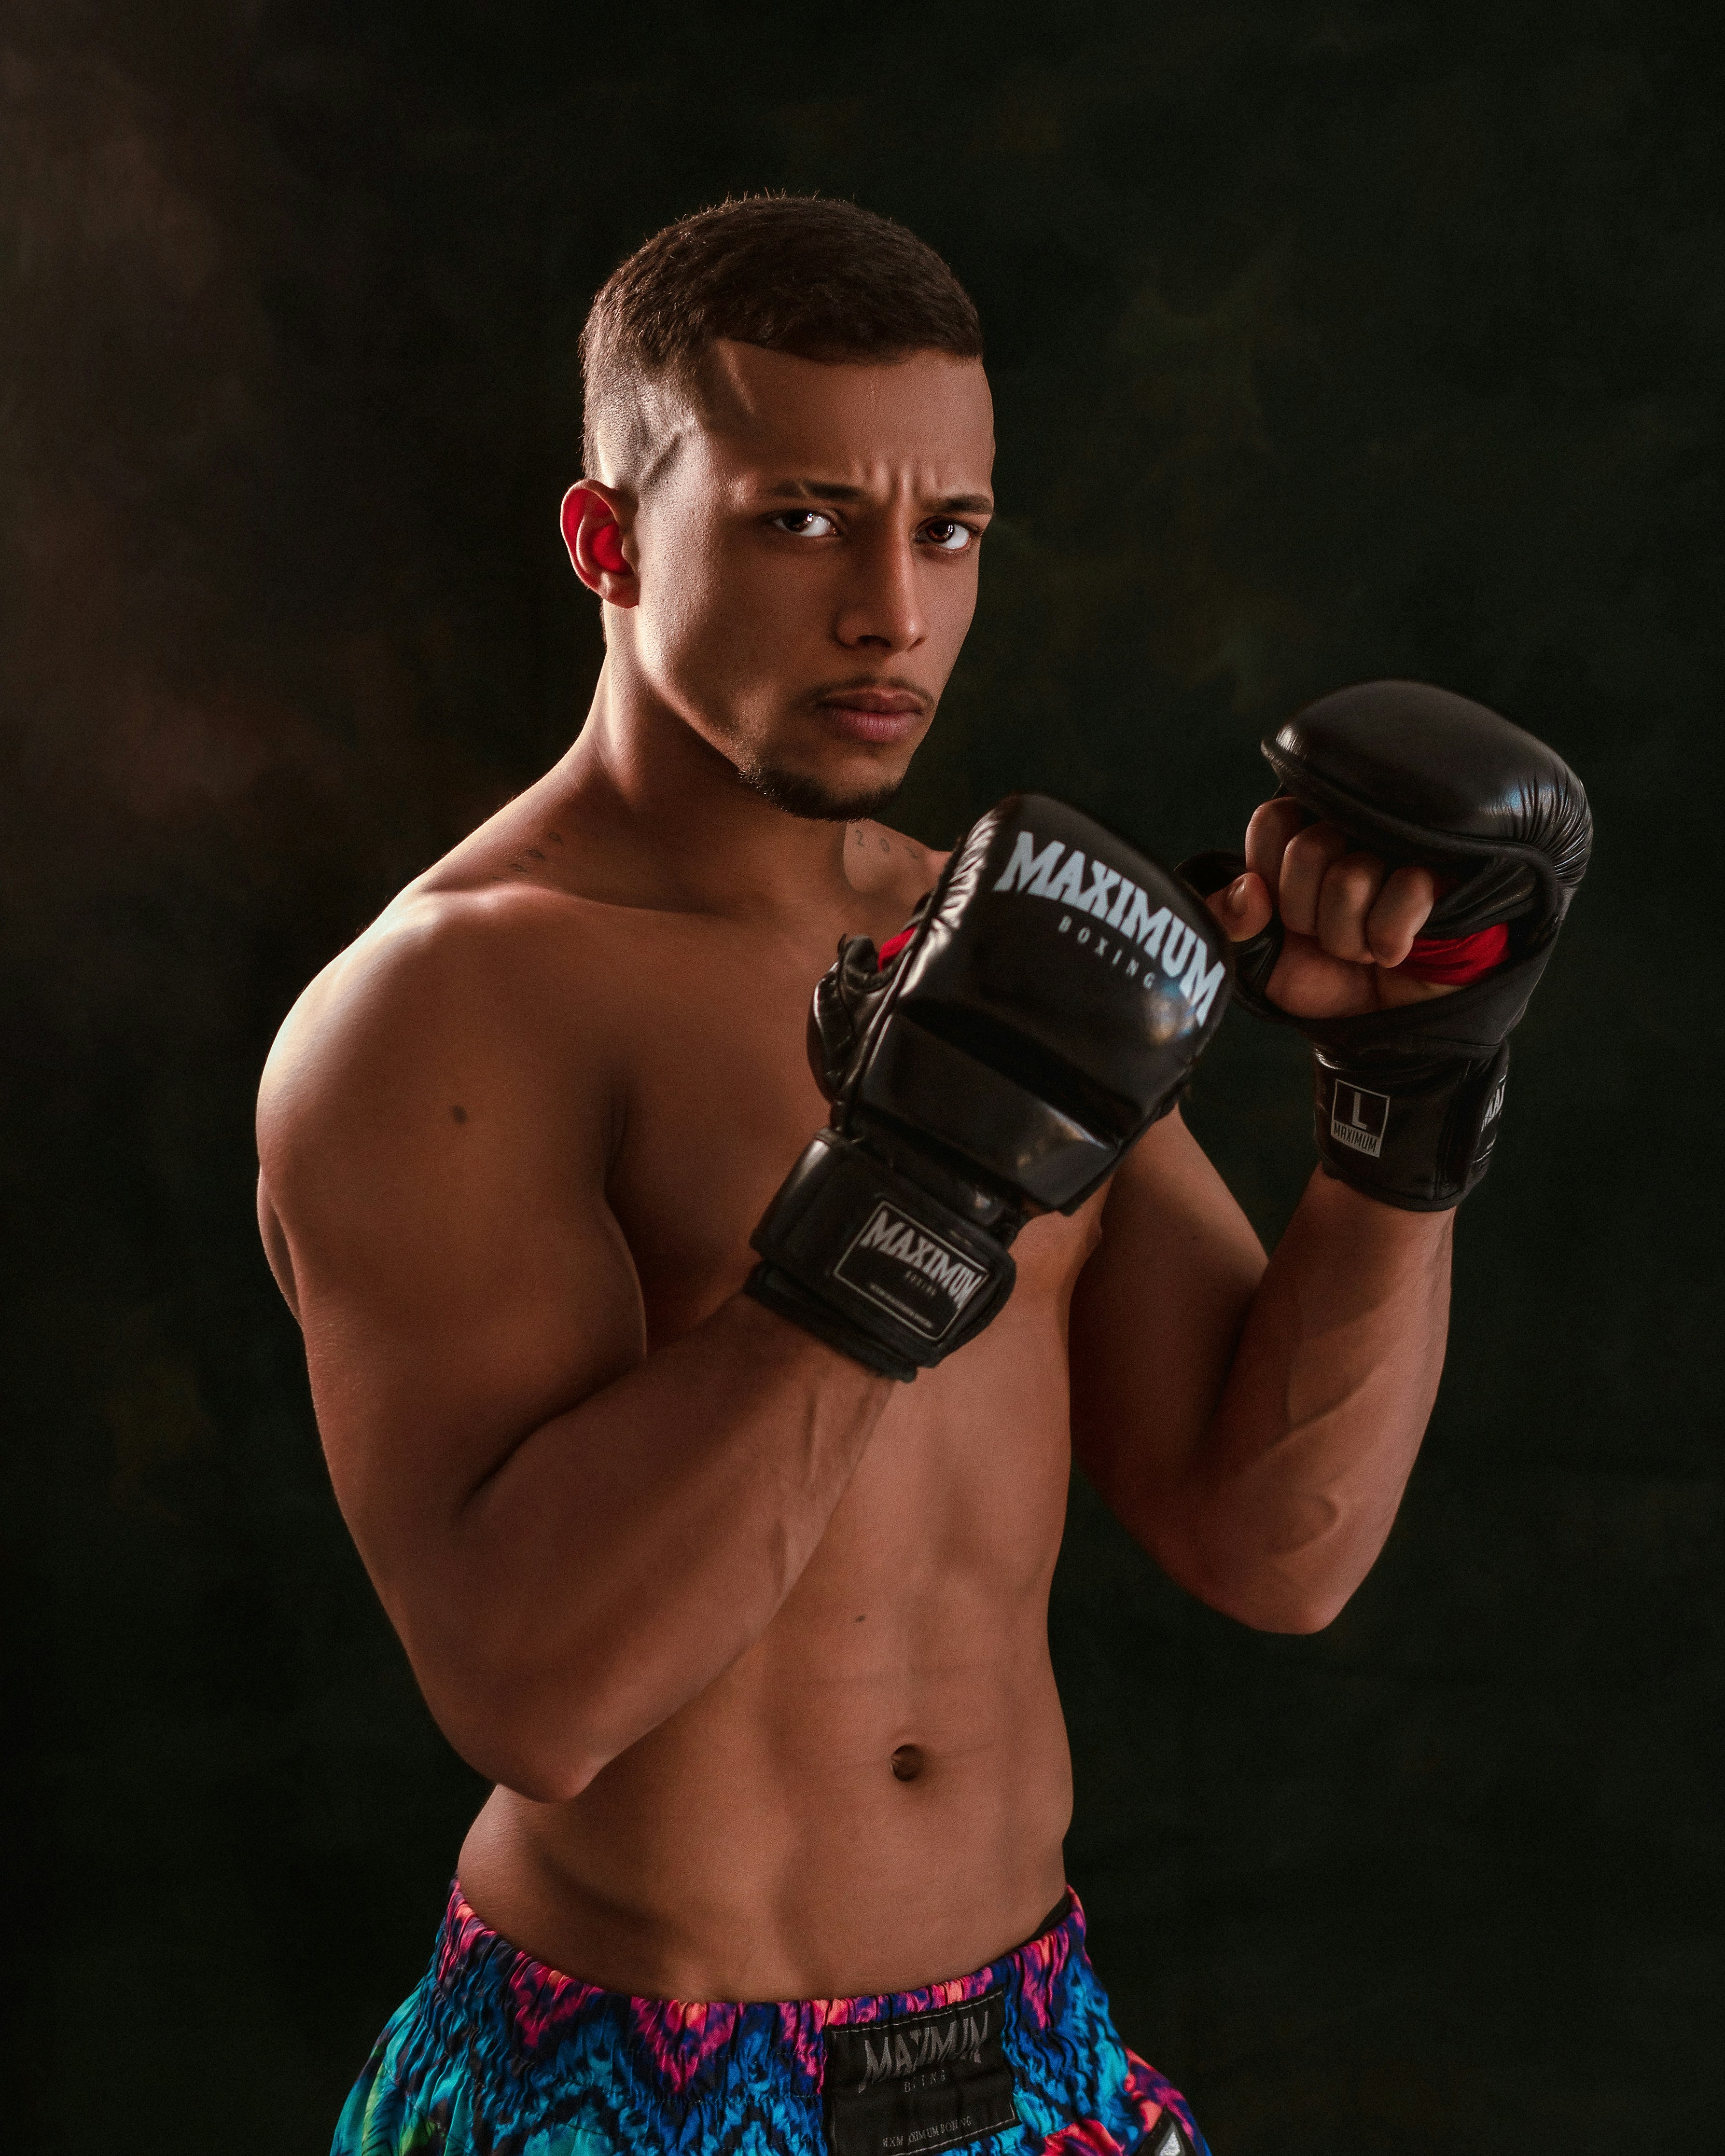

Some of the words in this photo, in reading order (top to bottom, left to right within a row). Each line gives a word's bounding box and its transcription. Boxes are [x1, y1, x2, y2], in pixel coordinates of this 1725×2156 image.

[992, 831, 1226, 1027] MAXIMUM
[1059, 915, 1155, 989] BOXING
[1334, 1121, 1377, 1152] MAXIMUM
[1352, 1091, 1367, 1130] L
[859, 1210, 982, 1309] MAXIMUM
[904, 2070, 946, 2093] BING
